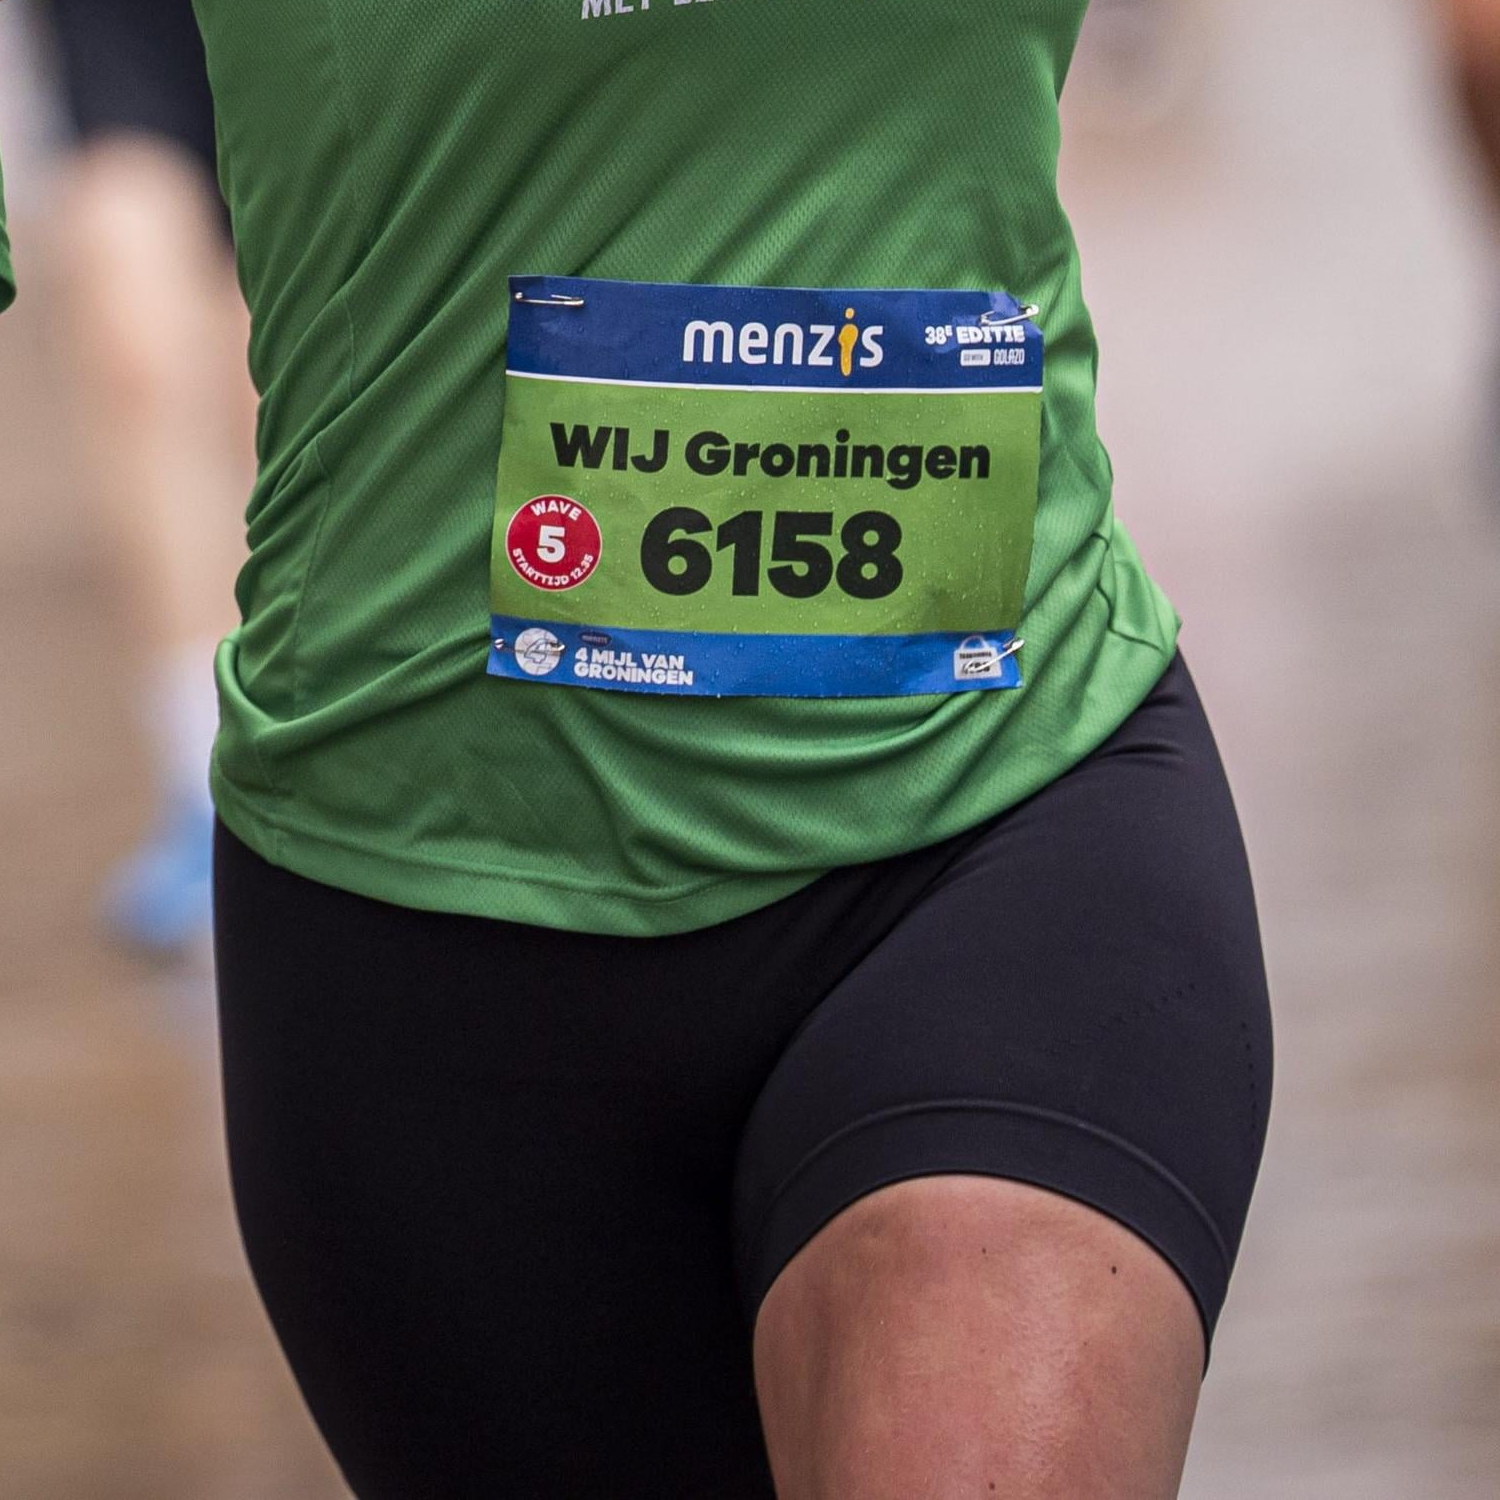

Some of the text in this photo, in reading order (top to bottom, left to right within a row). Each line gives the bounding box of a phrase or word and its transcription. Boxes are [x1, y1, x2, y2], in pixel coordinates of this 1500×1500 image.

[683, 307, 884, 377] menzis
[956, 325, 1025, 344] EDITIE
[994, 348, 1025, 366] GOLAZO
[550, 422, 991, 491] WIJ Groningen
[530, 500, 582, 521] WAVE
[536, 525, 566, 563] 5
[640, 506, 904, 600] 6158
[512, 548, 570, 586] STARTTIJD
[574, 647, 685, 671] 4 MIJL VAN
[574, 662, 694, 686] GRONINGEN
